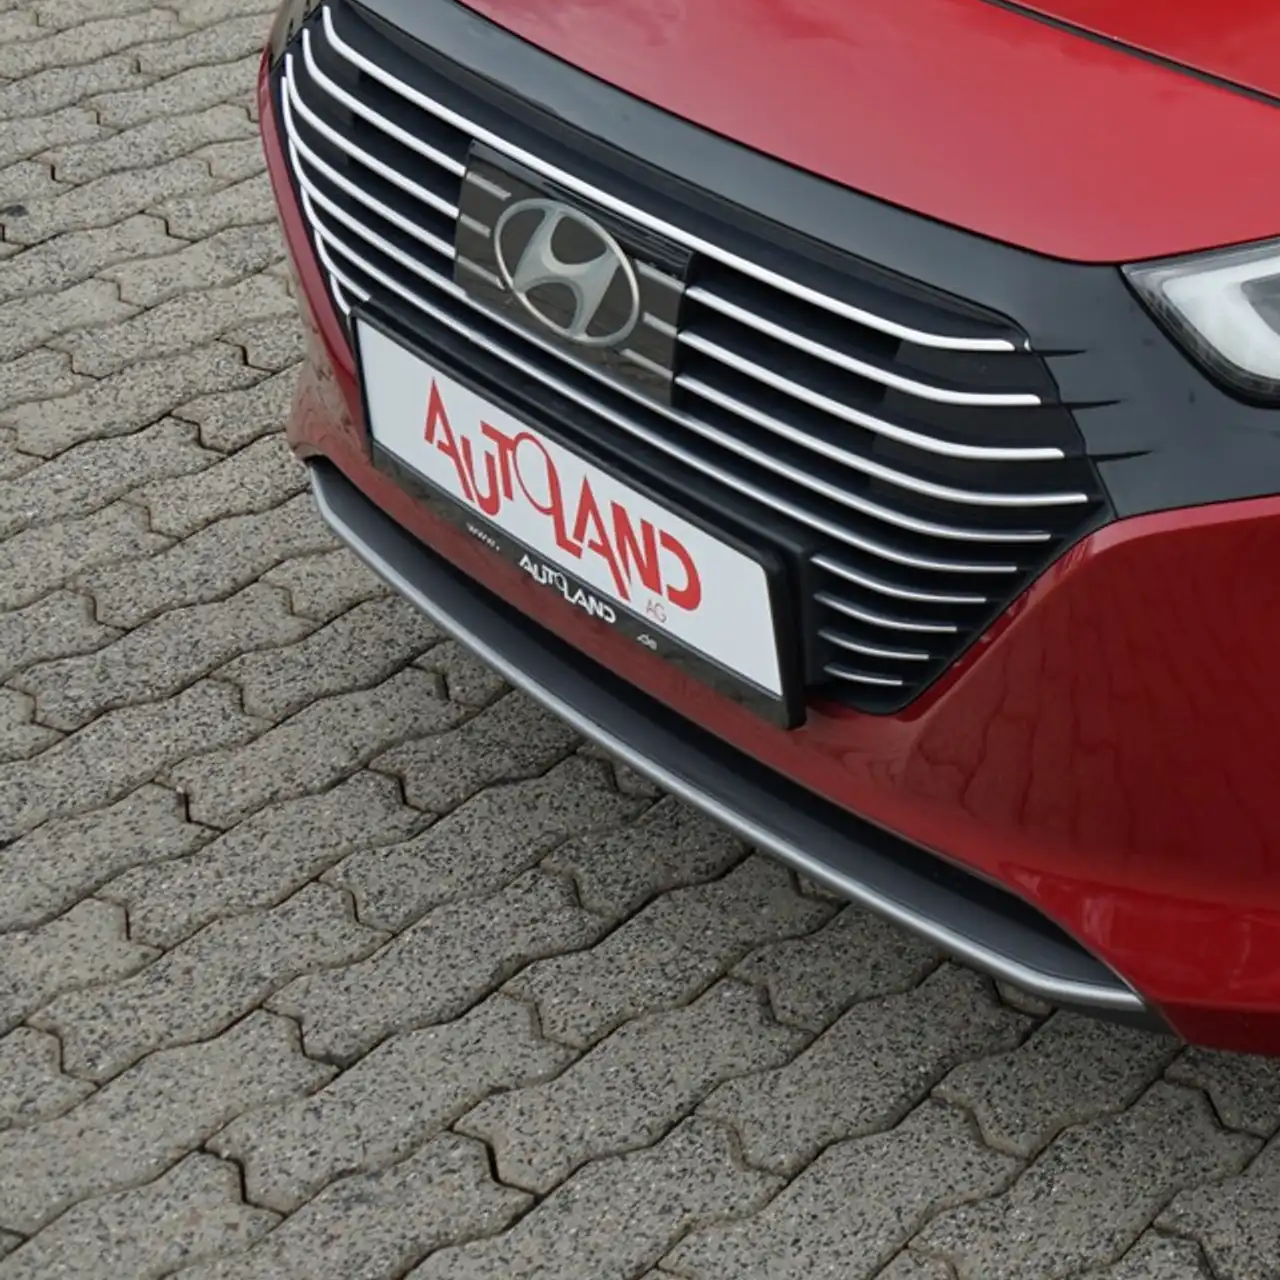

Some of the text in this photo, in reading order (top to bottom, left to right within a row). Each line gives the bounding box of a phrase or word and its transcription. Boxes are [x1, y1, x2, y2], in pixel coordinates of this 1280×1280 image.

[424, 376, 702, 611] AUTOLAND
[518, 553, 617, 624] AUTOLAND
[646, 598, 668, 623] AG
